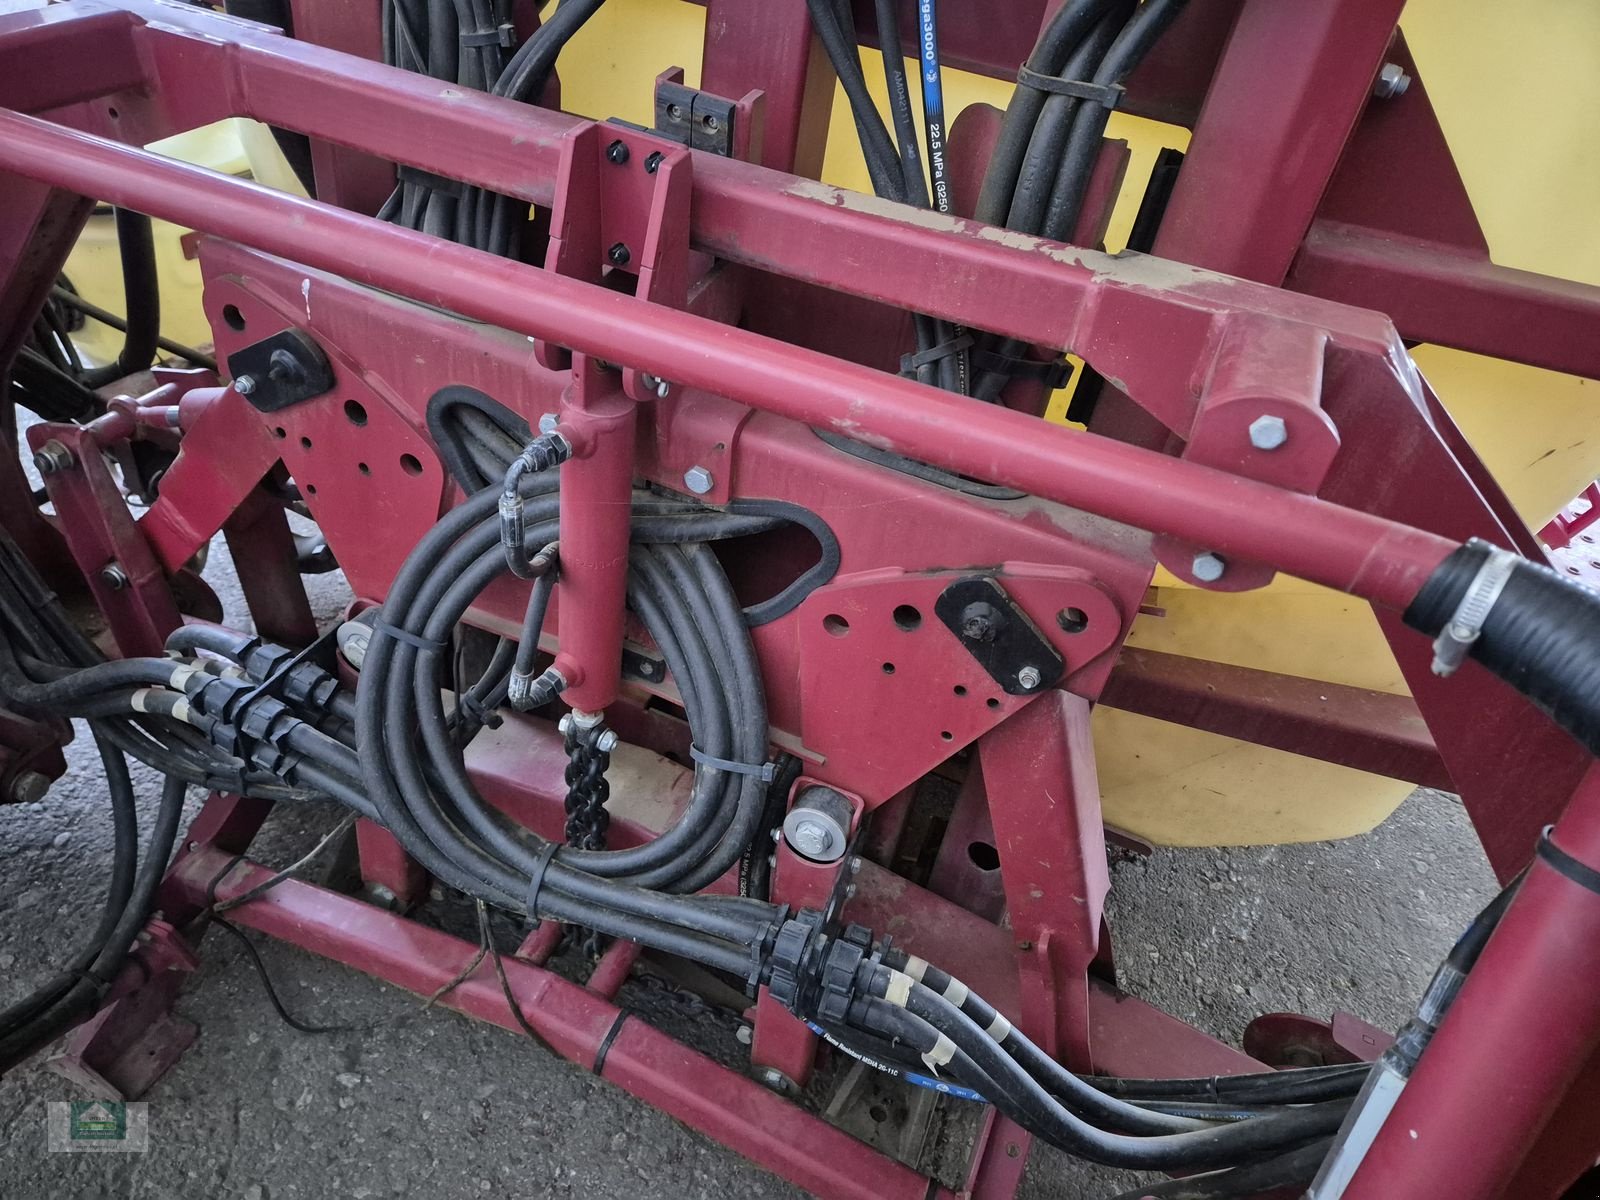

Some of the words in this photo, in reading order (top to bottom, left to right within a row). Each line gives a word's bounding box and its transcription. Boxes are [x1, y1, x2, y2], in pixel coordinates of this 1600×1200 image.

[930, 123, 941, 150] 22.5
[933, 151, 945, 178] MPa
[935, 180, 948, 212] (3250
[741, 859, 750, 876] MPa
[823, 1032, 840, 1048] Flame
